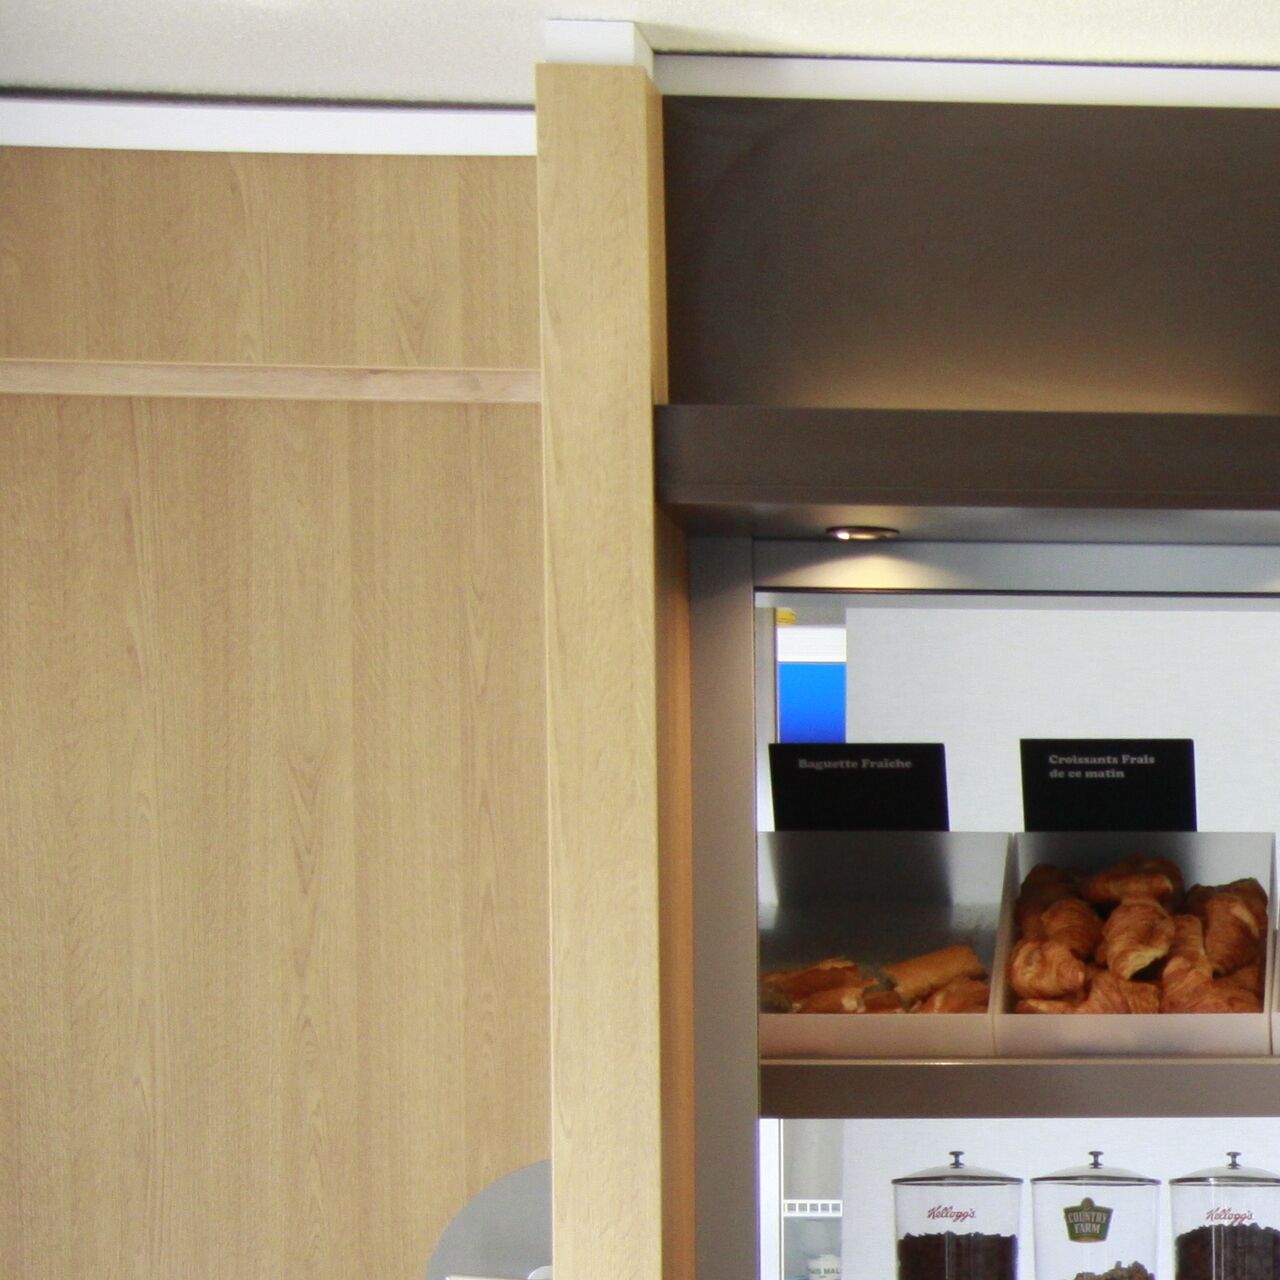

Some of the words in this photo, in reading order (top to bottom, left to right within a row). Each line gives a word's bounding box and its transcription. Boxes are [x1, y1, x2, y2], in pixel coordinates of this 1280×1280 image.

[797, 758, 858, 771] Baguette
[1048, 754, 1119, 765] Croissants
[1121, 754, 1156, 765] Frais
[1049, 768, 1065, 779] de
[1067, 770, 1082, 779] ce
[1084, 768, 1125, 779] matin
[927, 1204, 976, 1222] Kellogg's
[1067, 1211, 1107, 1224] COUNTRY
[1206, 1207, 1254, 1225] Kellogg's
[1074, 1223, 1100, 1234] FARM
